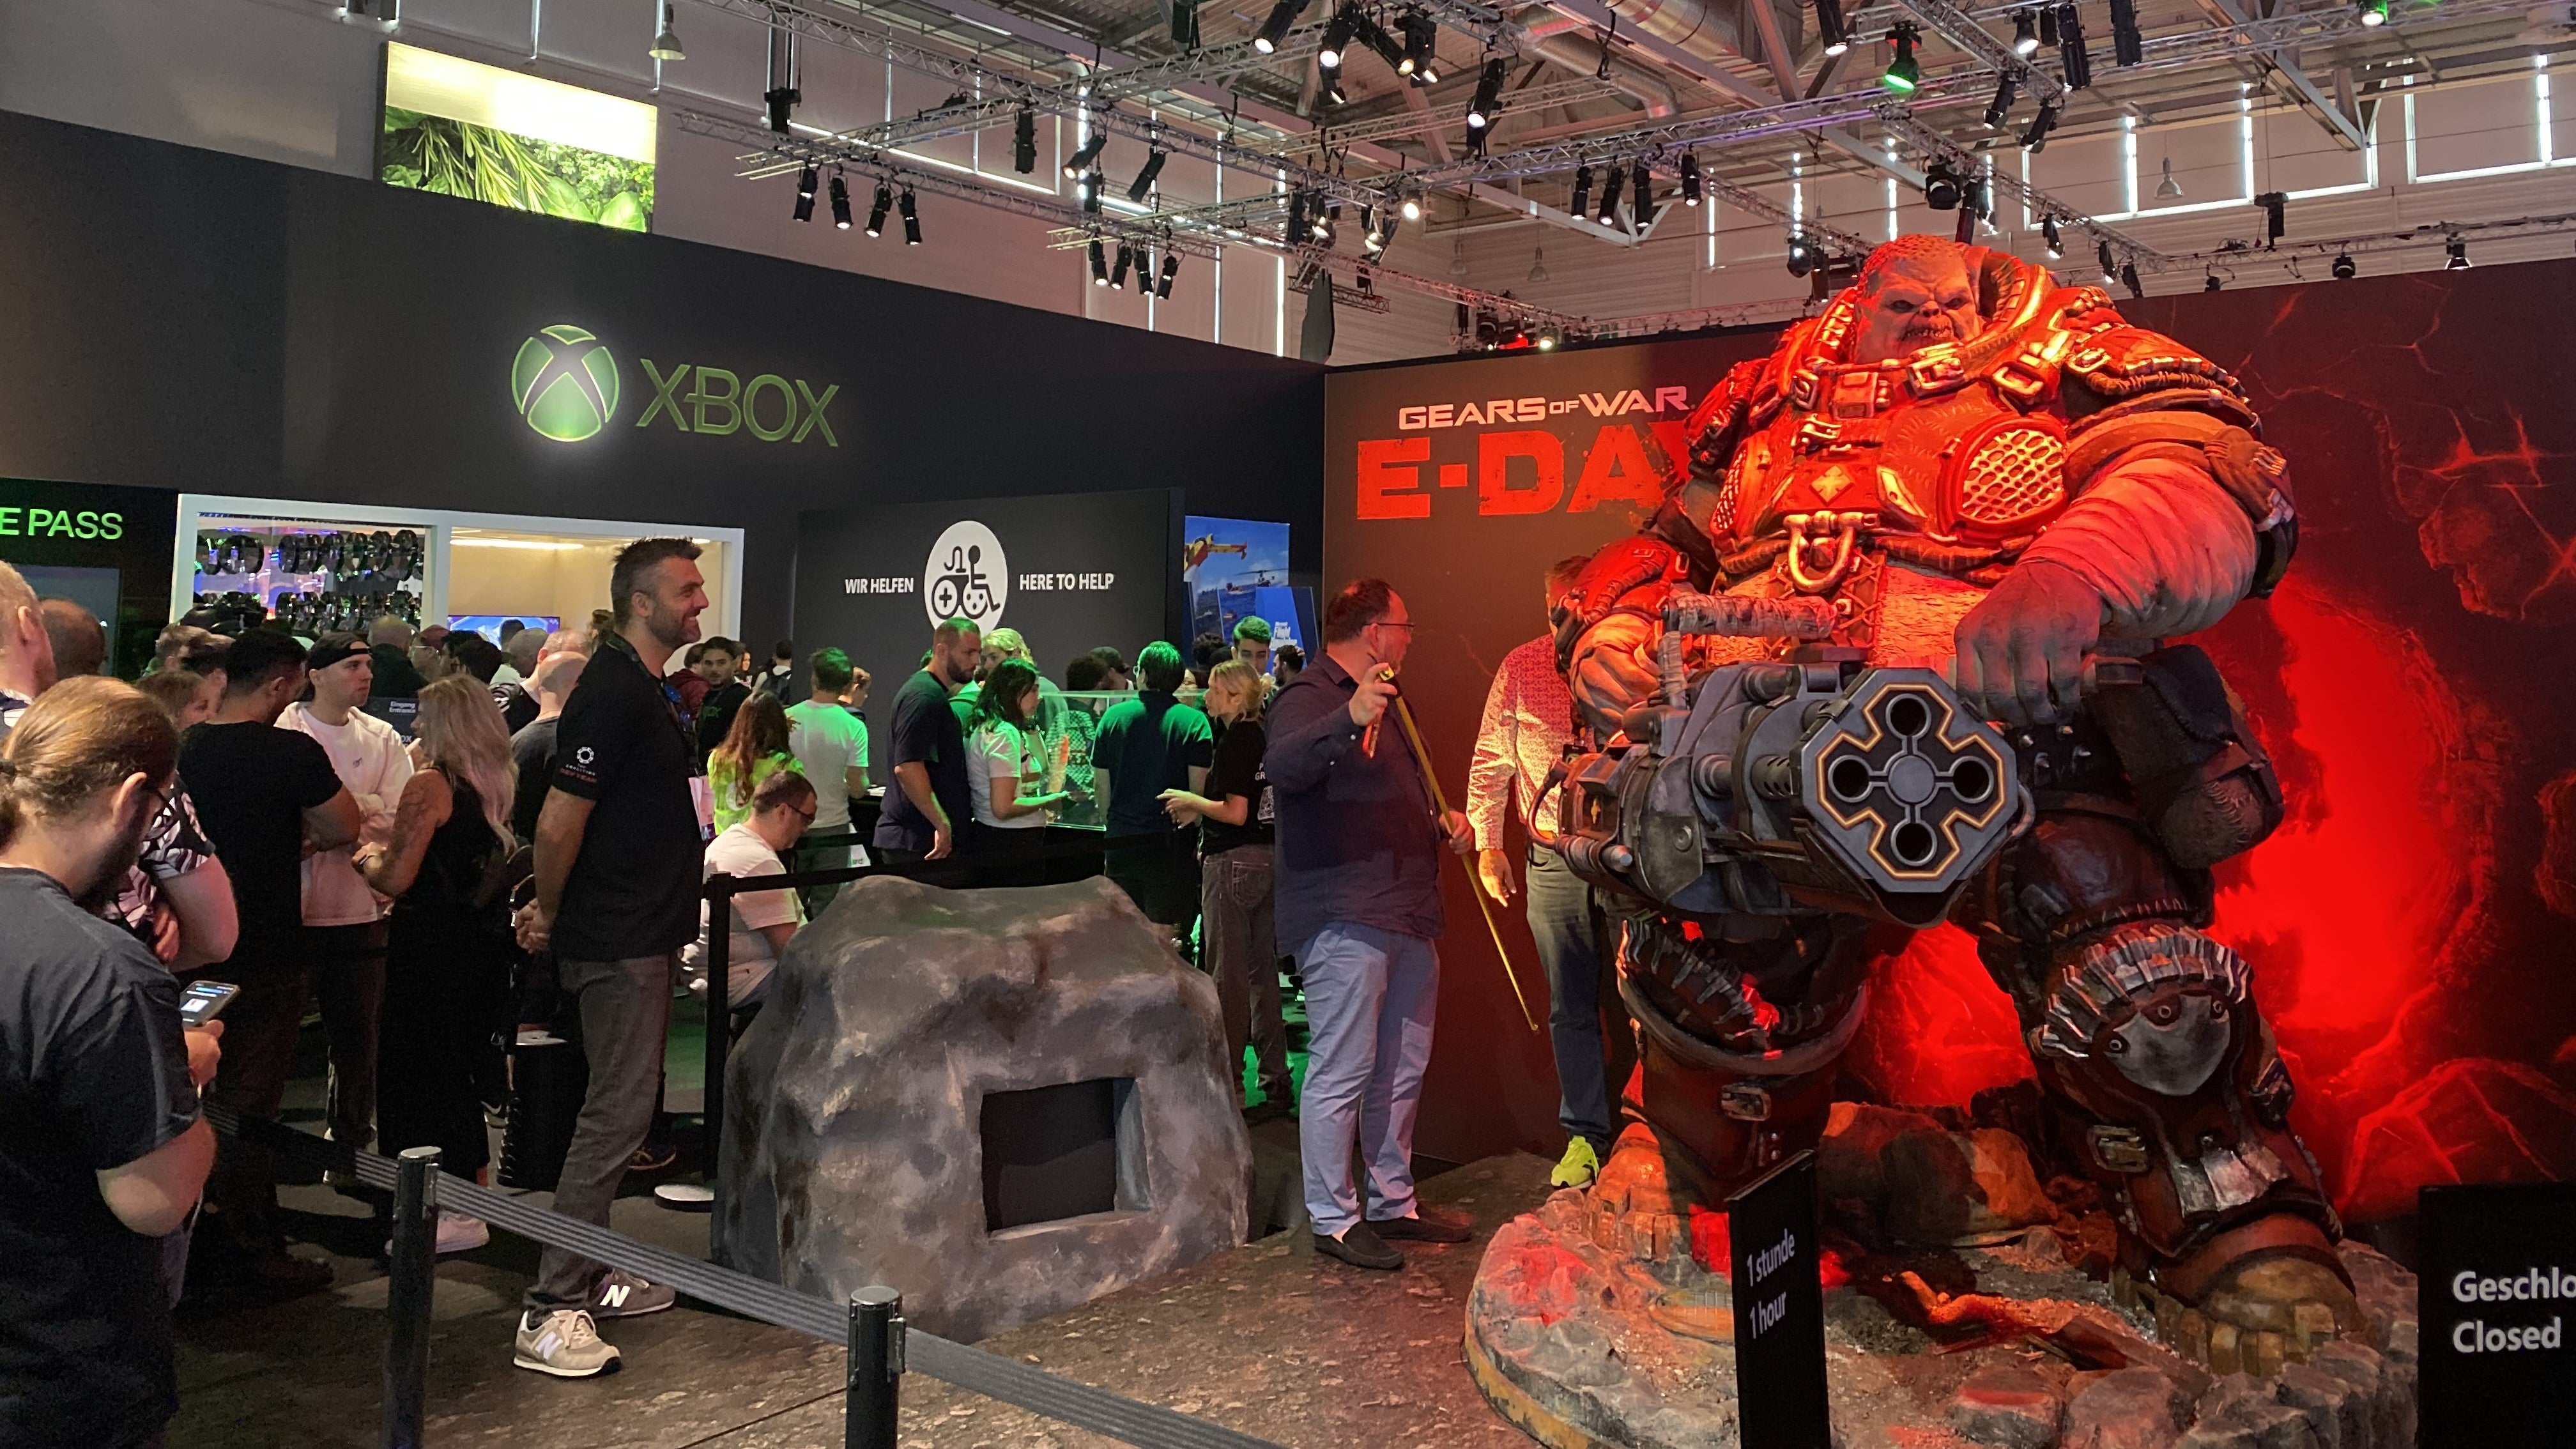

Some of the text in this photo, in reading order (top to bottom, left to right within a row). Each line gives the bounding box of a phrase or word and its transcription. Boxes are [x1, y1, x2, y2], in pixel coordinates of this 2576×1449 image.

[635, 358, 840, 447] XBOX
[1399, 397, 1545, 430] GEARS
[1549, 400, 1580, 415] OF
[27, 509, 123, 540] PASS
[845, 578, 914, 594] WIR HELFEN
[1019, 572, 1114, 591] HERE TO HELP
[1747, 1228, 1795, 1287] 1 stunde
[600, 1284, 631, 1307] N
[2453, 1266, 2576, 1303] Geschlo
[1749, 1291, 1787, 1339] 1 hour
[535, 1331, 564, 1360] N
[2453, 1316, 2562, 1354] Closed
